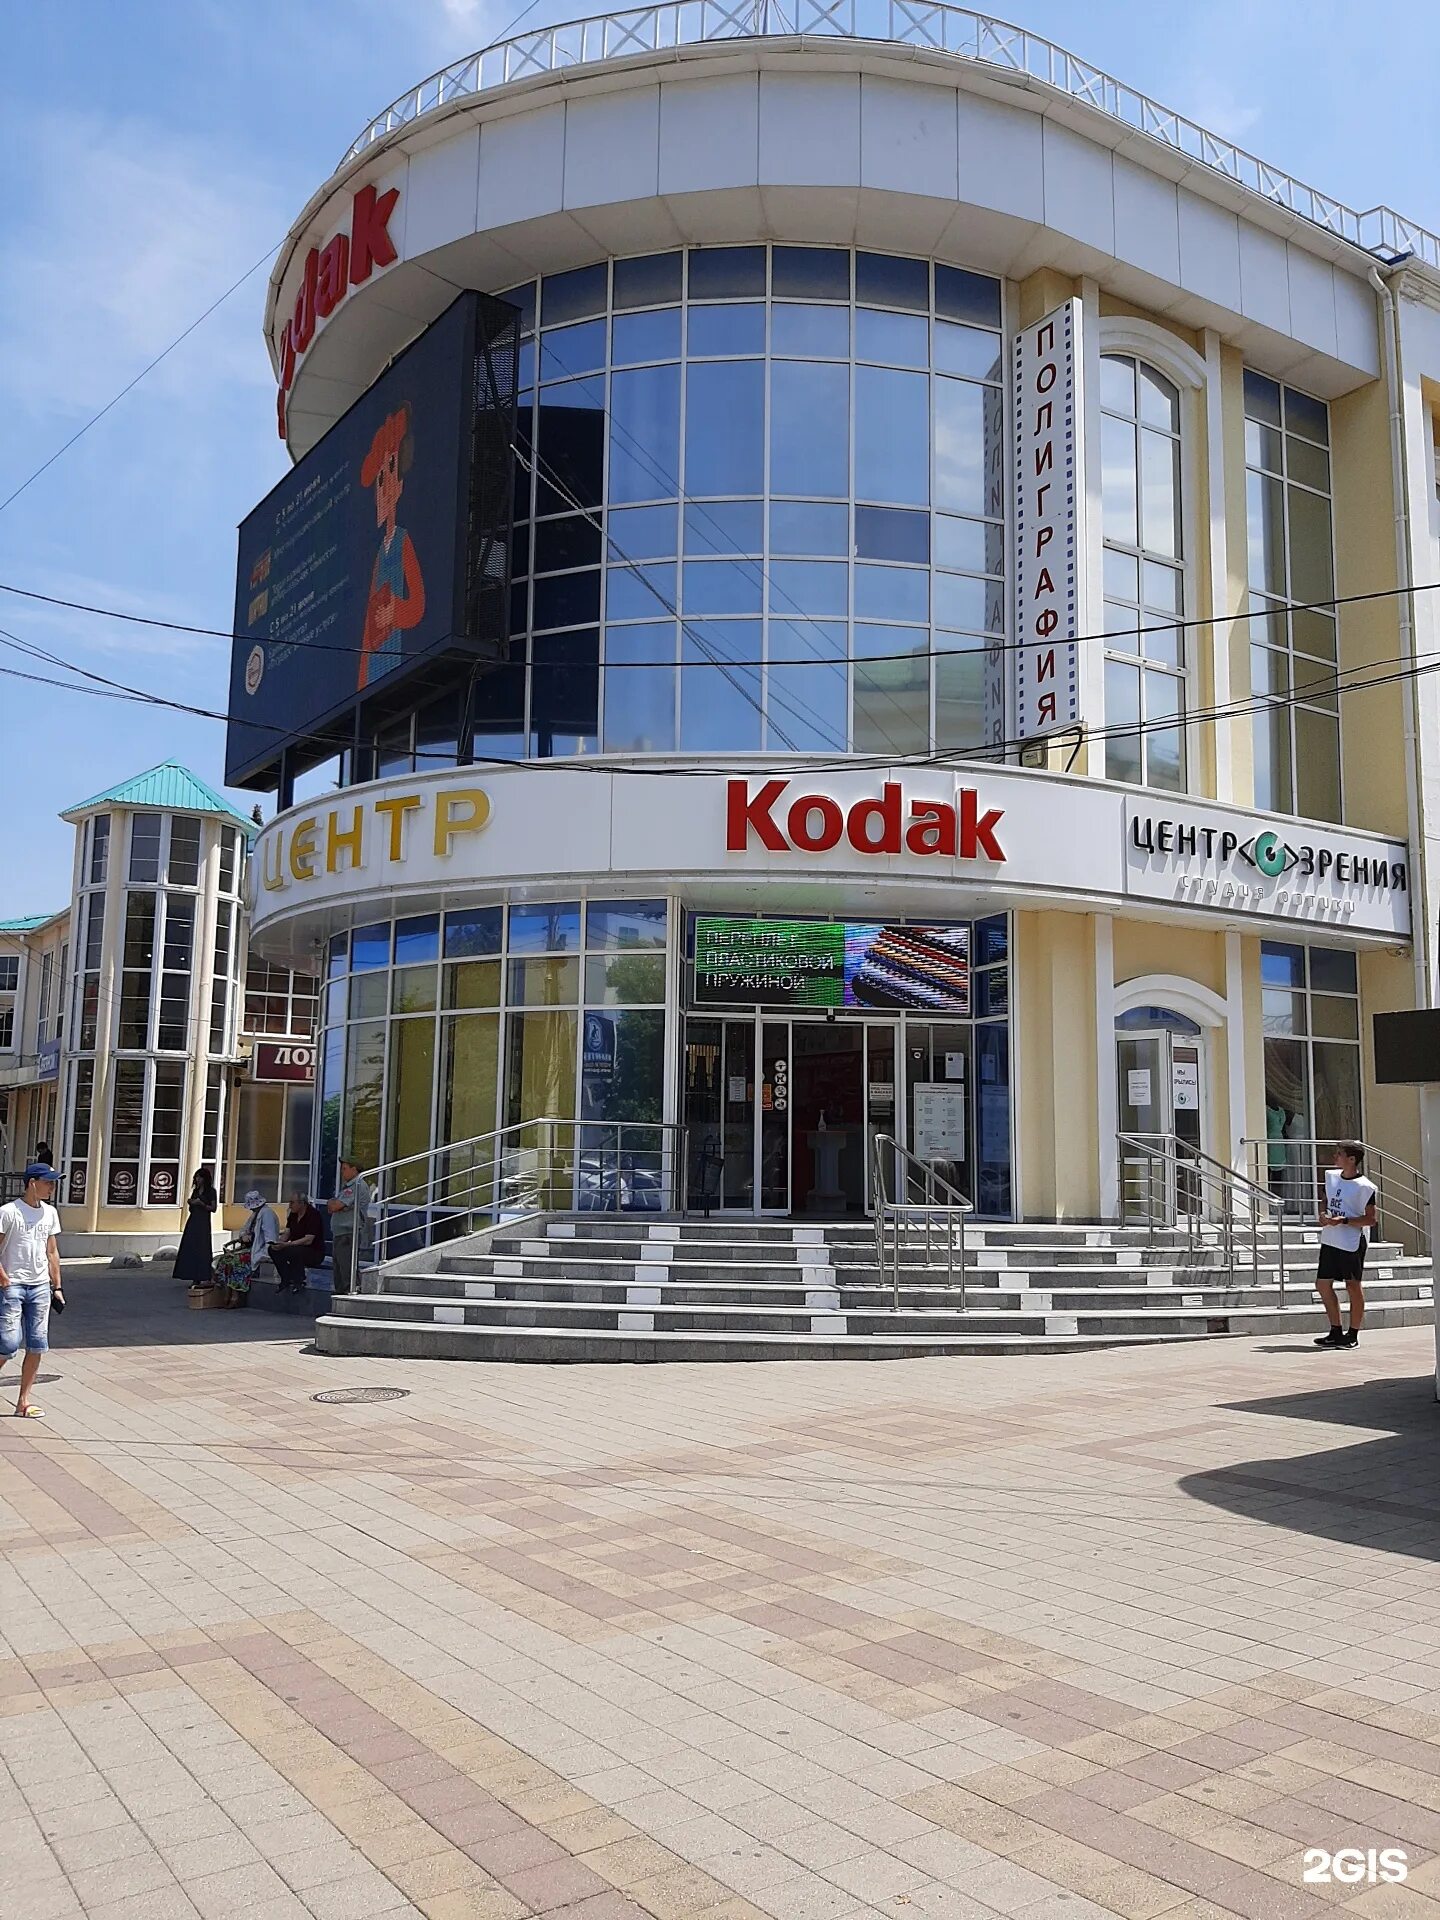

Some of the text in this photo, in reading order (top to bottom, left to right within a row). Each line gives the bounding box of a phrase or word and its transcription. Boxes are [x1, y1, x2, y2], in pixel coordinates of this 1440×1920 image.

[277, 184, 400, 440] odak
[1033, 322, 1059, 727] ПОЛИГРАФИЯ
[263, 788, 493, 892] ЦЕНТР
[725, 778, 1009, 864] Kodak
[1132, 815, 1407, 892] ЦЕНТР ЗРЕНИЯ
[705, 951, 834, 970] ПЛАСТИКОВОЙ
[705, 971, 806, 990] ПРУЖИНОЙ
